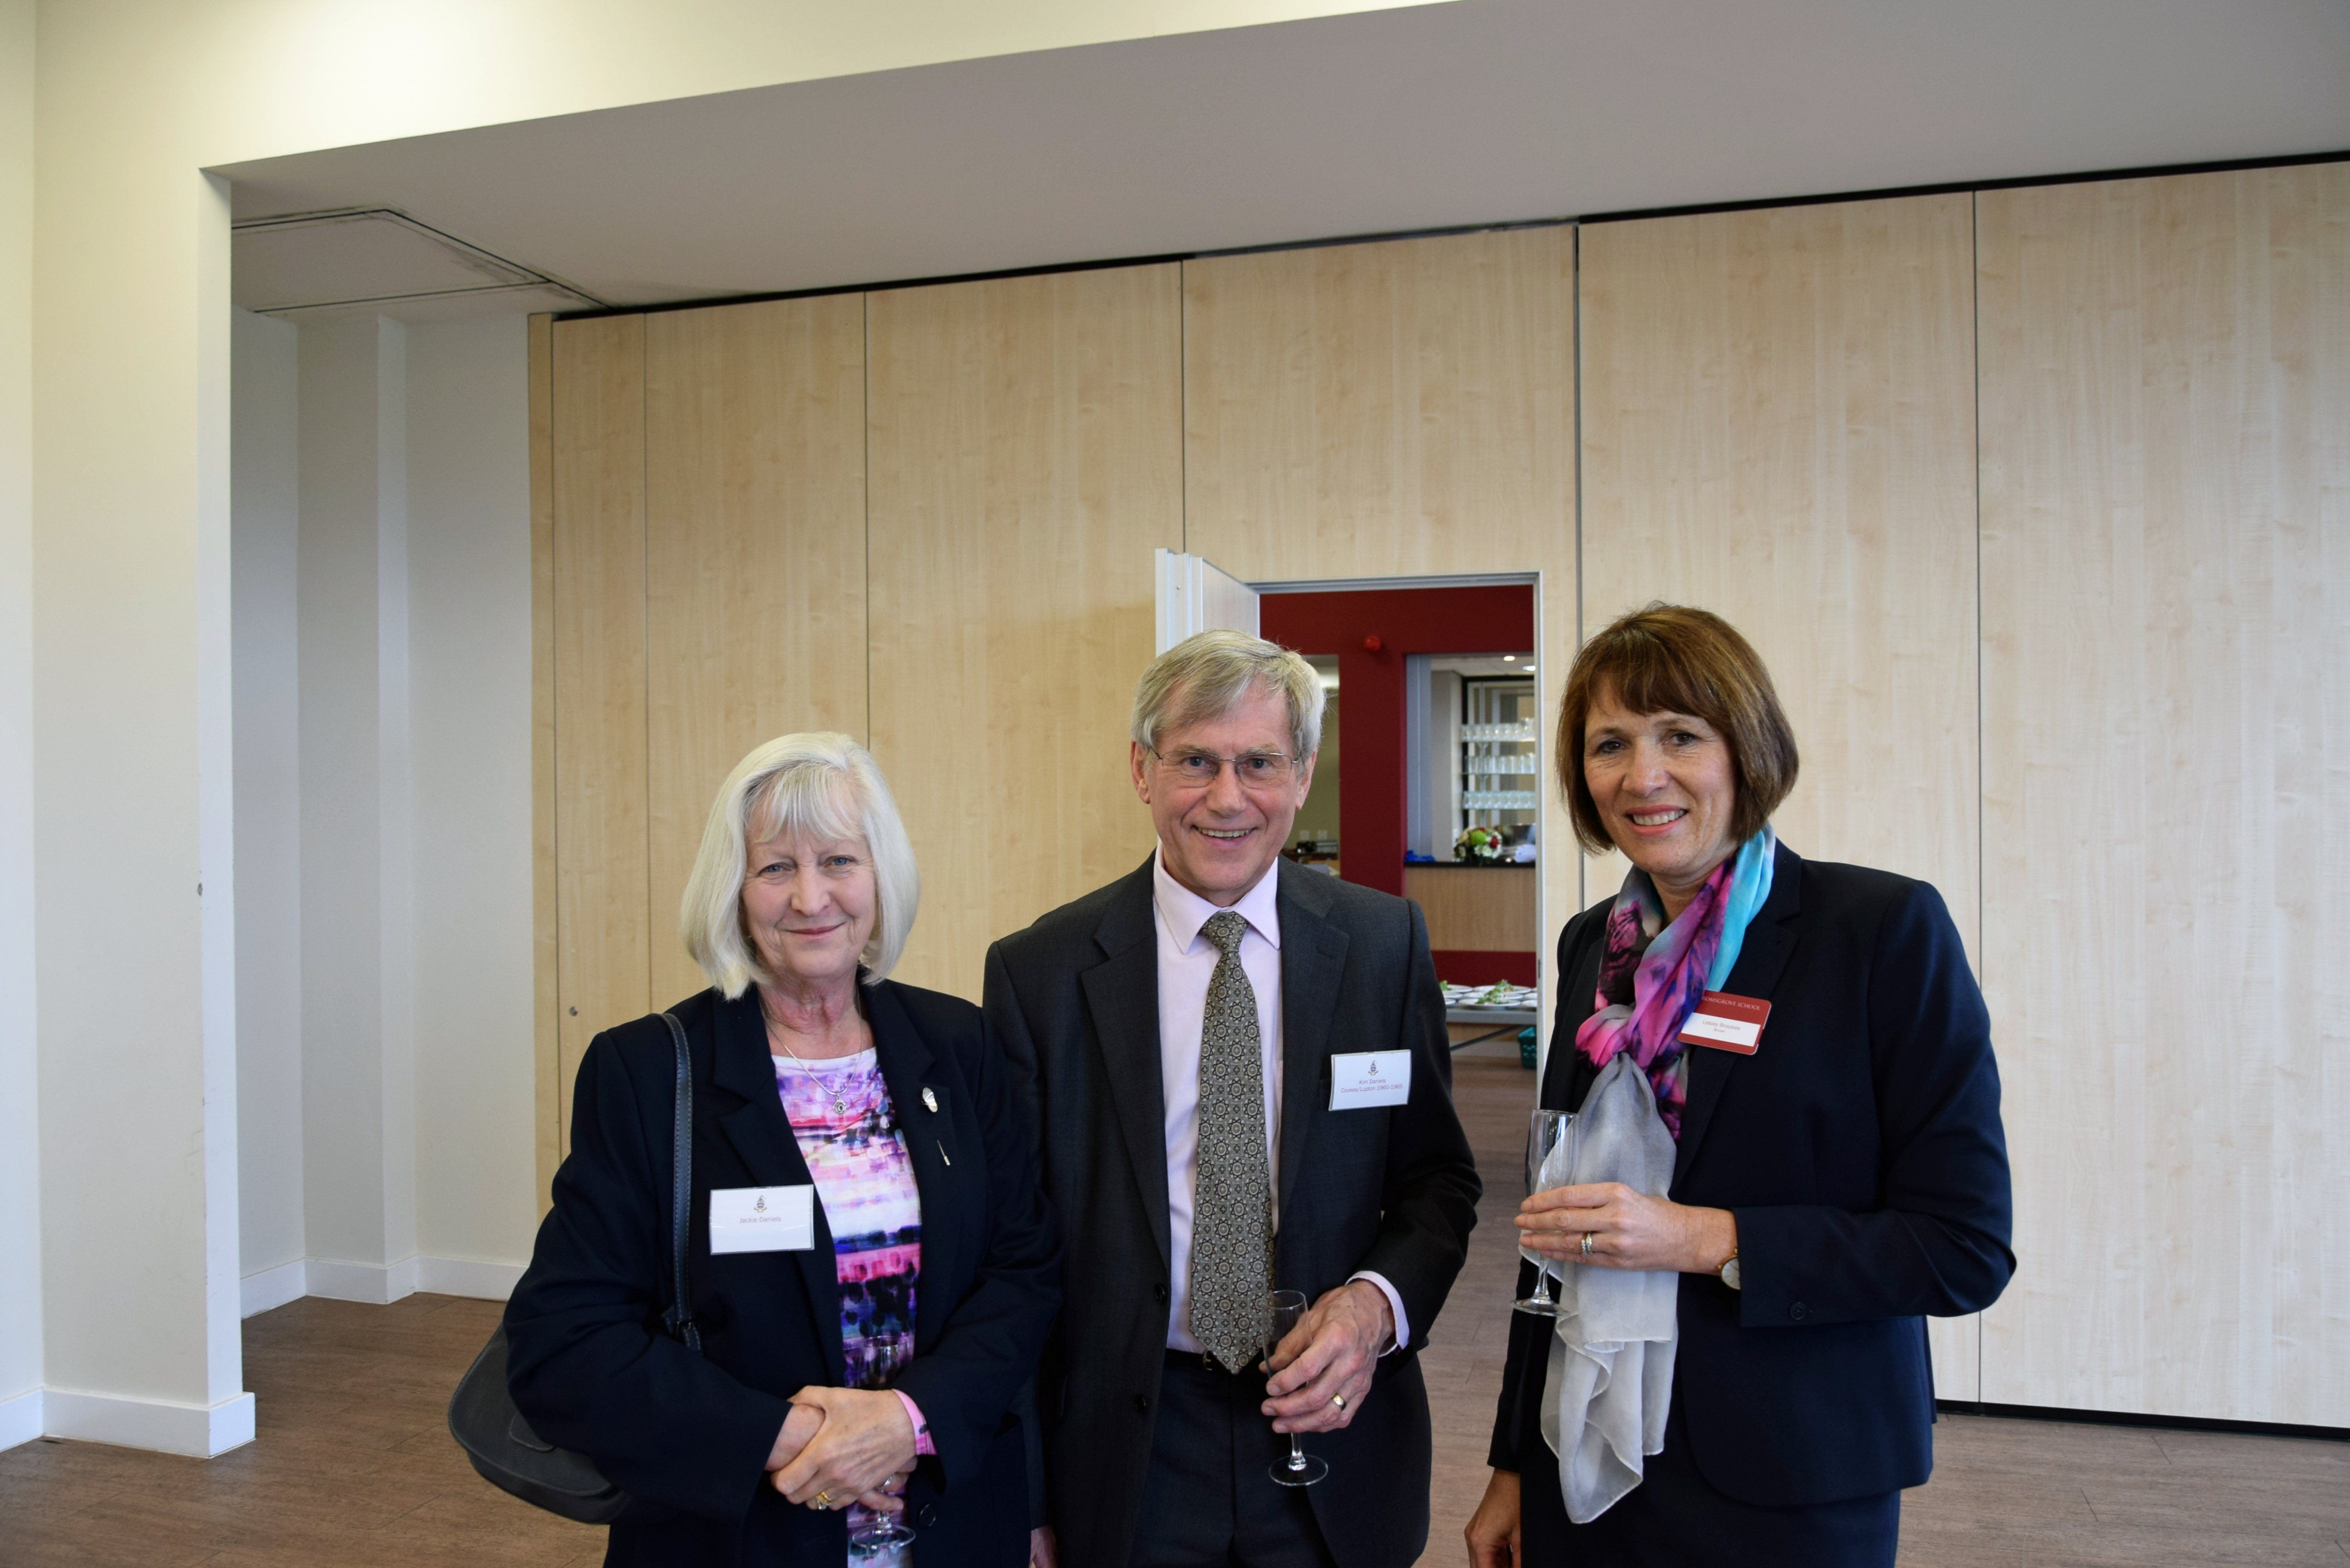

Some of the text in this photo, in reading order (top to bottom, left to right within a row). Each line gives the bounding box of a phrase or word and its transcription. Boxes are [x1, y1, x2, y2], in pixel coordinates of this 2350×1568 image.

[1701, 996, 1760, 1011] ROMSGROVE SCHOOL
[1719, 1022, 1741, 1031] Brookes
